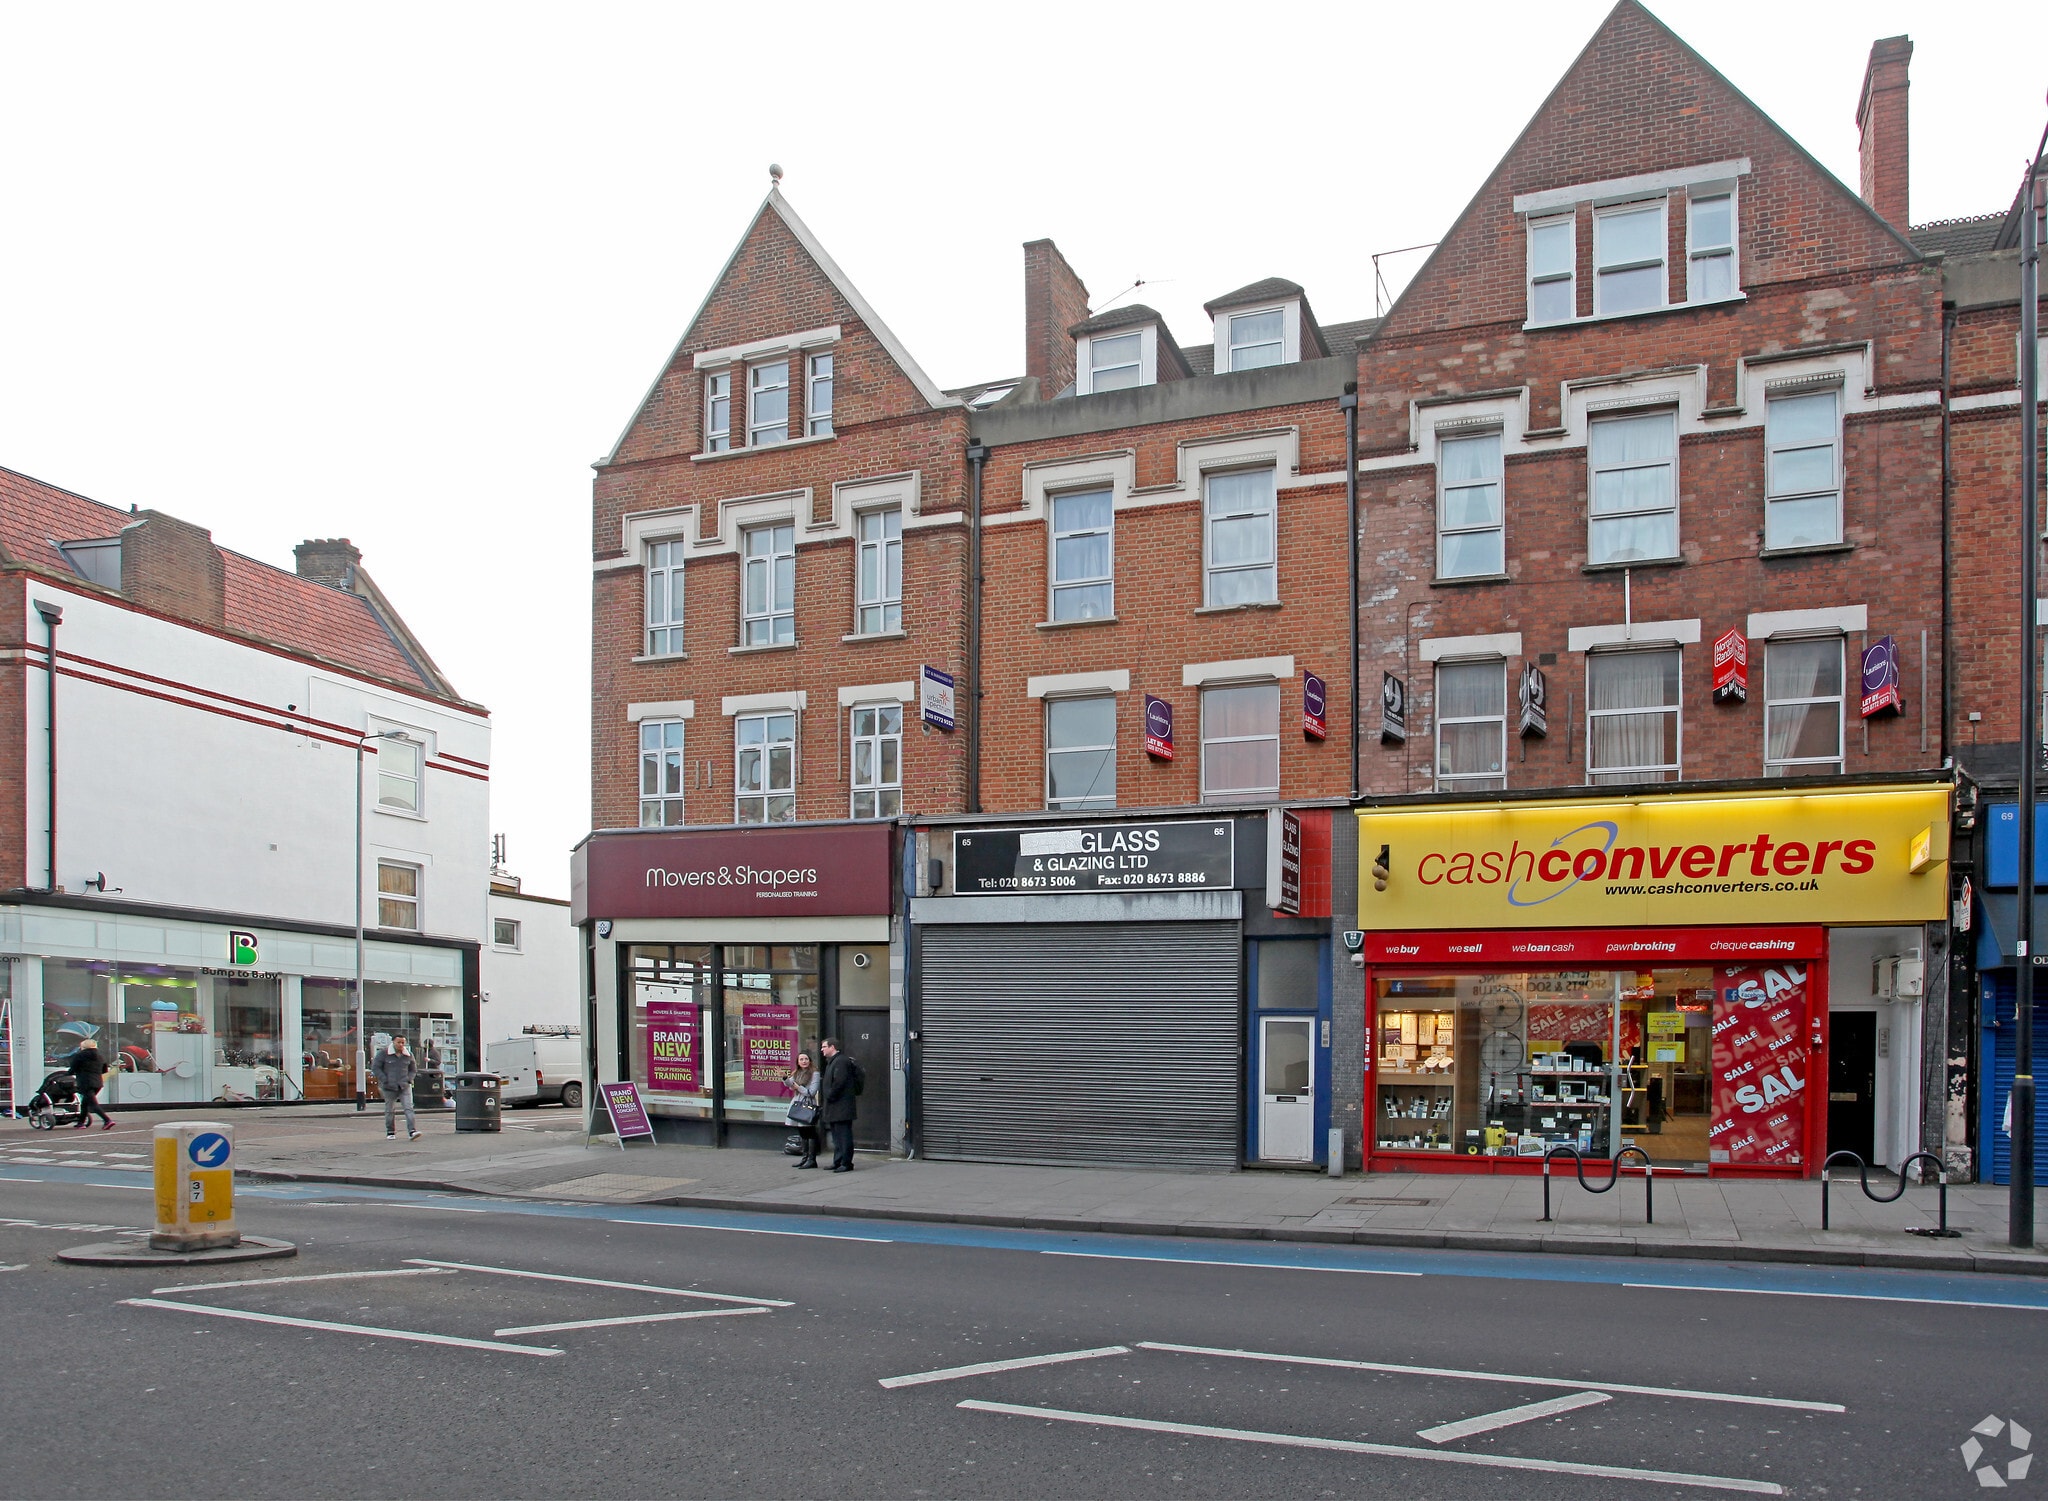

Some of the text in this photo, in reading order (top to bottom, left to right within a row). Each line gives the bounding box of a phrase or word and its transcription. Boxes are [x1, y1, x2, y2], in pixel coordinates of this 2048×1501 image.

[1721, 687, 1728, 697] to
[926, 694, 943, 705] urban
[1862, 697, 1872, 707] LET
[1148, 737, 1156, 746] LET
[2001, 812, 2014, 820] 69
[1214, 828, 1225, 836] 65
[1284, 819, 1297, 835] GLASS
[962, 838, 972, 846] 65
[1081, 830, 1160, 853] GLASS
[1282, 840, 1299, 857] GLAZING
[1033, 855, 1149, 872] & GLAZING LTD
[1282, 858, 1299, 873] MIRRORS
[978, 876, 1076, 888] Tel: 020 8673 5006
[1097, 872, 1206, 886] Fax: 020 8673 8886
[1605, 879, 1819, 895] www.cashconverters.co.uk
[1527, 943, 1550, 952] loan
[1551, 943, 1575, 952] cash
[1606, 941, 1676, 953] pawnbroking
[1710, 939, 1795, 952] cheque cashing
[202, 967, 279, 980] Bump to Baby
[1530, 1009, 1566, 1034] SALE
[1570, 1009, 1607, 1034] SALE
[1771, 1008, 1791, 1022] SALE
[653, 1031, 691, 1042] BRAND
[1734, 1030, 1758, 1047] SALE
[1768, 1034, 1793, 1051] SALE
[653, 1042, 691, 1057] NEW
[750, 1039, 790, 1049] DOUBLE
[654, 1072, 692, 1081] TRAINING
[1723, 1061, 1754, 1082] SALE
[612, 1095, 634, 1104] NEW
[1769, 1114, 1789, 1128] SALE
[1731, 1135, 1755, 1151] SALE
[1765, 1140, 1790, 1156] SALE
